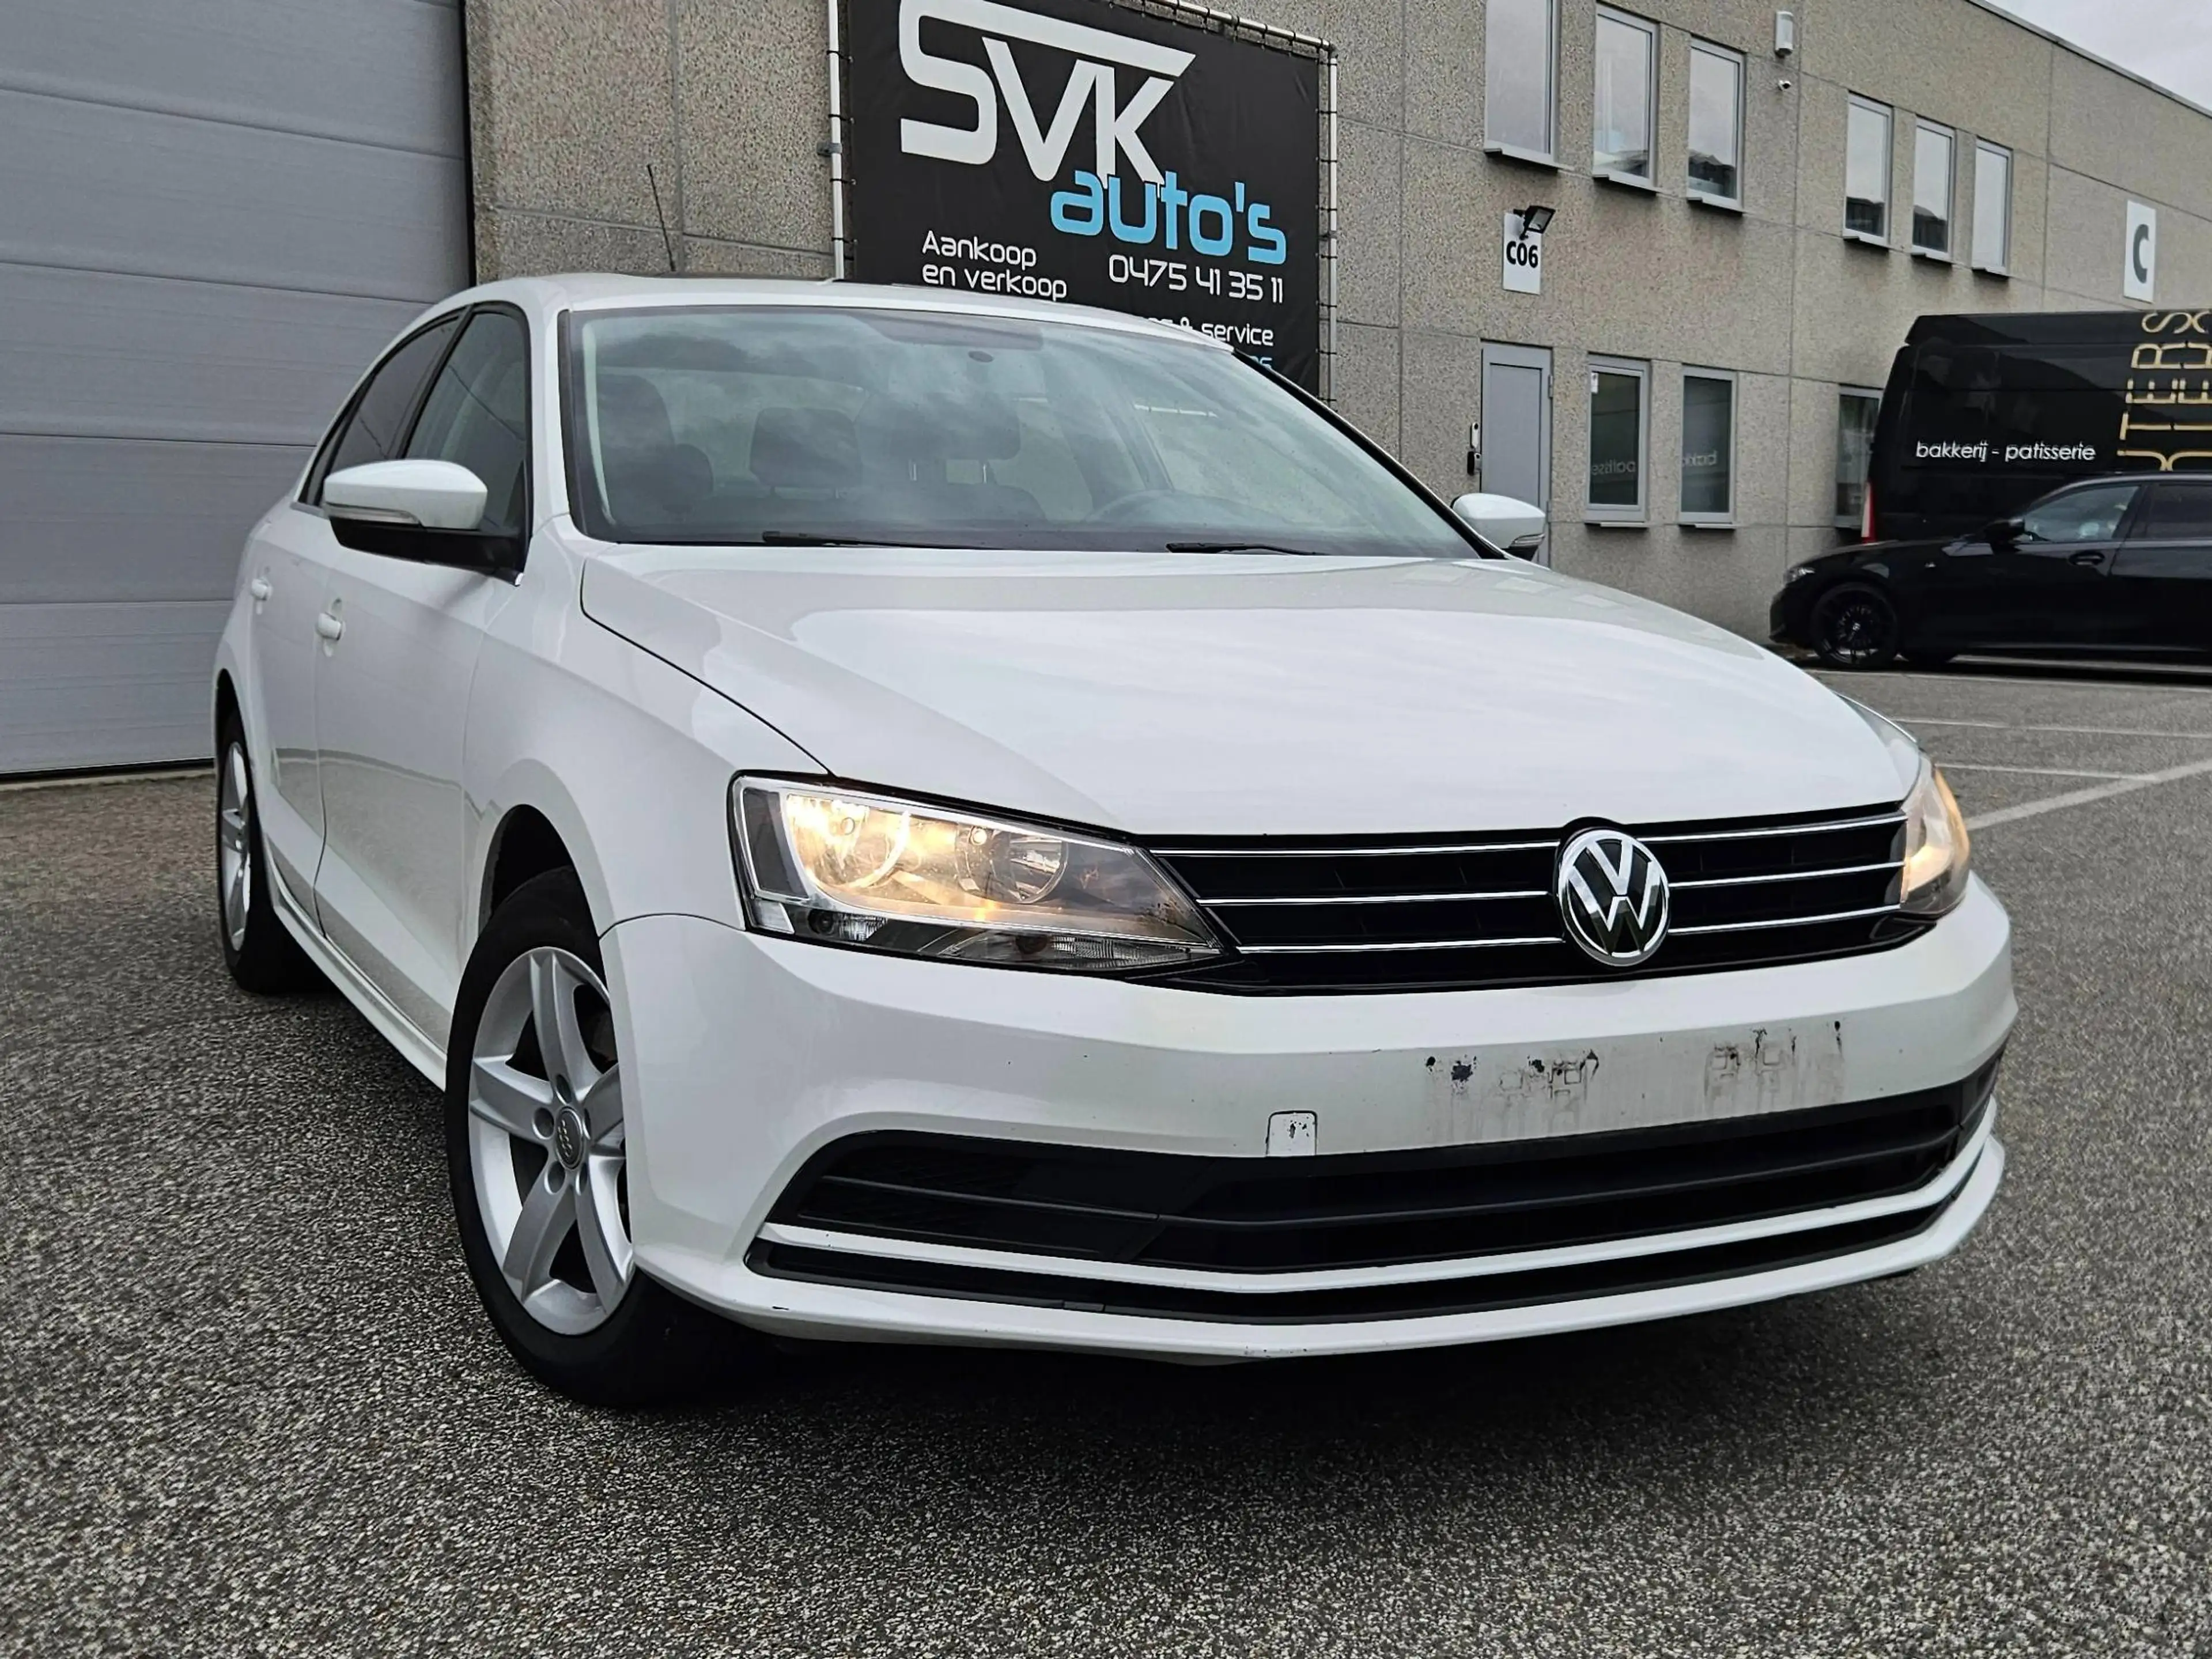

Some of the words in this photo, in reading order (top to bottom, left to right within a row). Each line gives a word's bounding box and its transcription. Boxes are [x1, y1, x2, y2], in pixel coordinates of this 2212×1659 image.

[899, 0, 1196, 198] SVK
[1050, 170, 1286, 264] auto's
[922, 230, 1037, 271] Aankoop
[1506, 241, 1538, 268] C06
[2133, 224, 2149, 283] C
[922, 264, 955, 286] en
[964, 268, 1067, 301] verkoop
[1109, 254, 1187, 291] 0475
[1196, 266, 1220, 296] 41
[1228, 271, 1264, 301] 35
[1271, 276, 1283, 303] 11
[1201, 323, 1274, 346] service
[1916, 440, 1988, 462] bakkerij
[2005, 441, 2097, 462] patisserie
